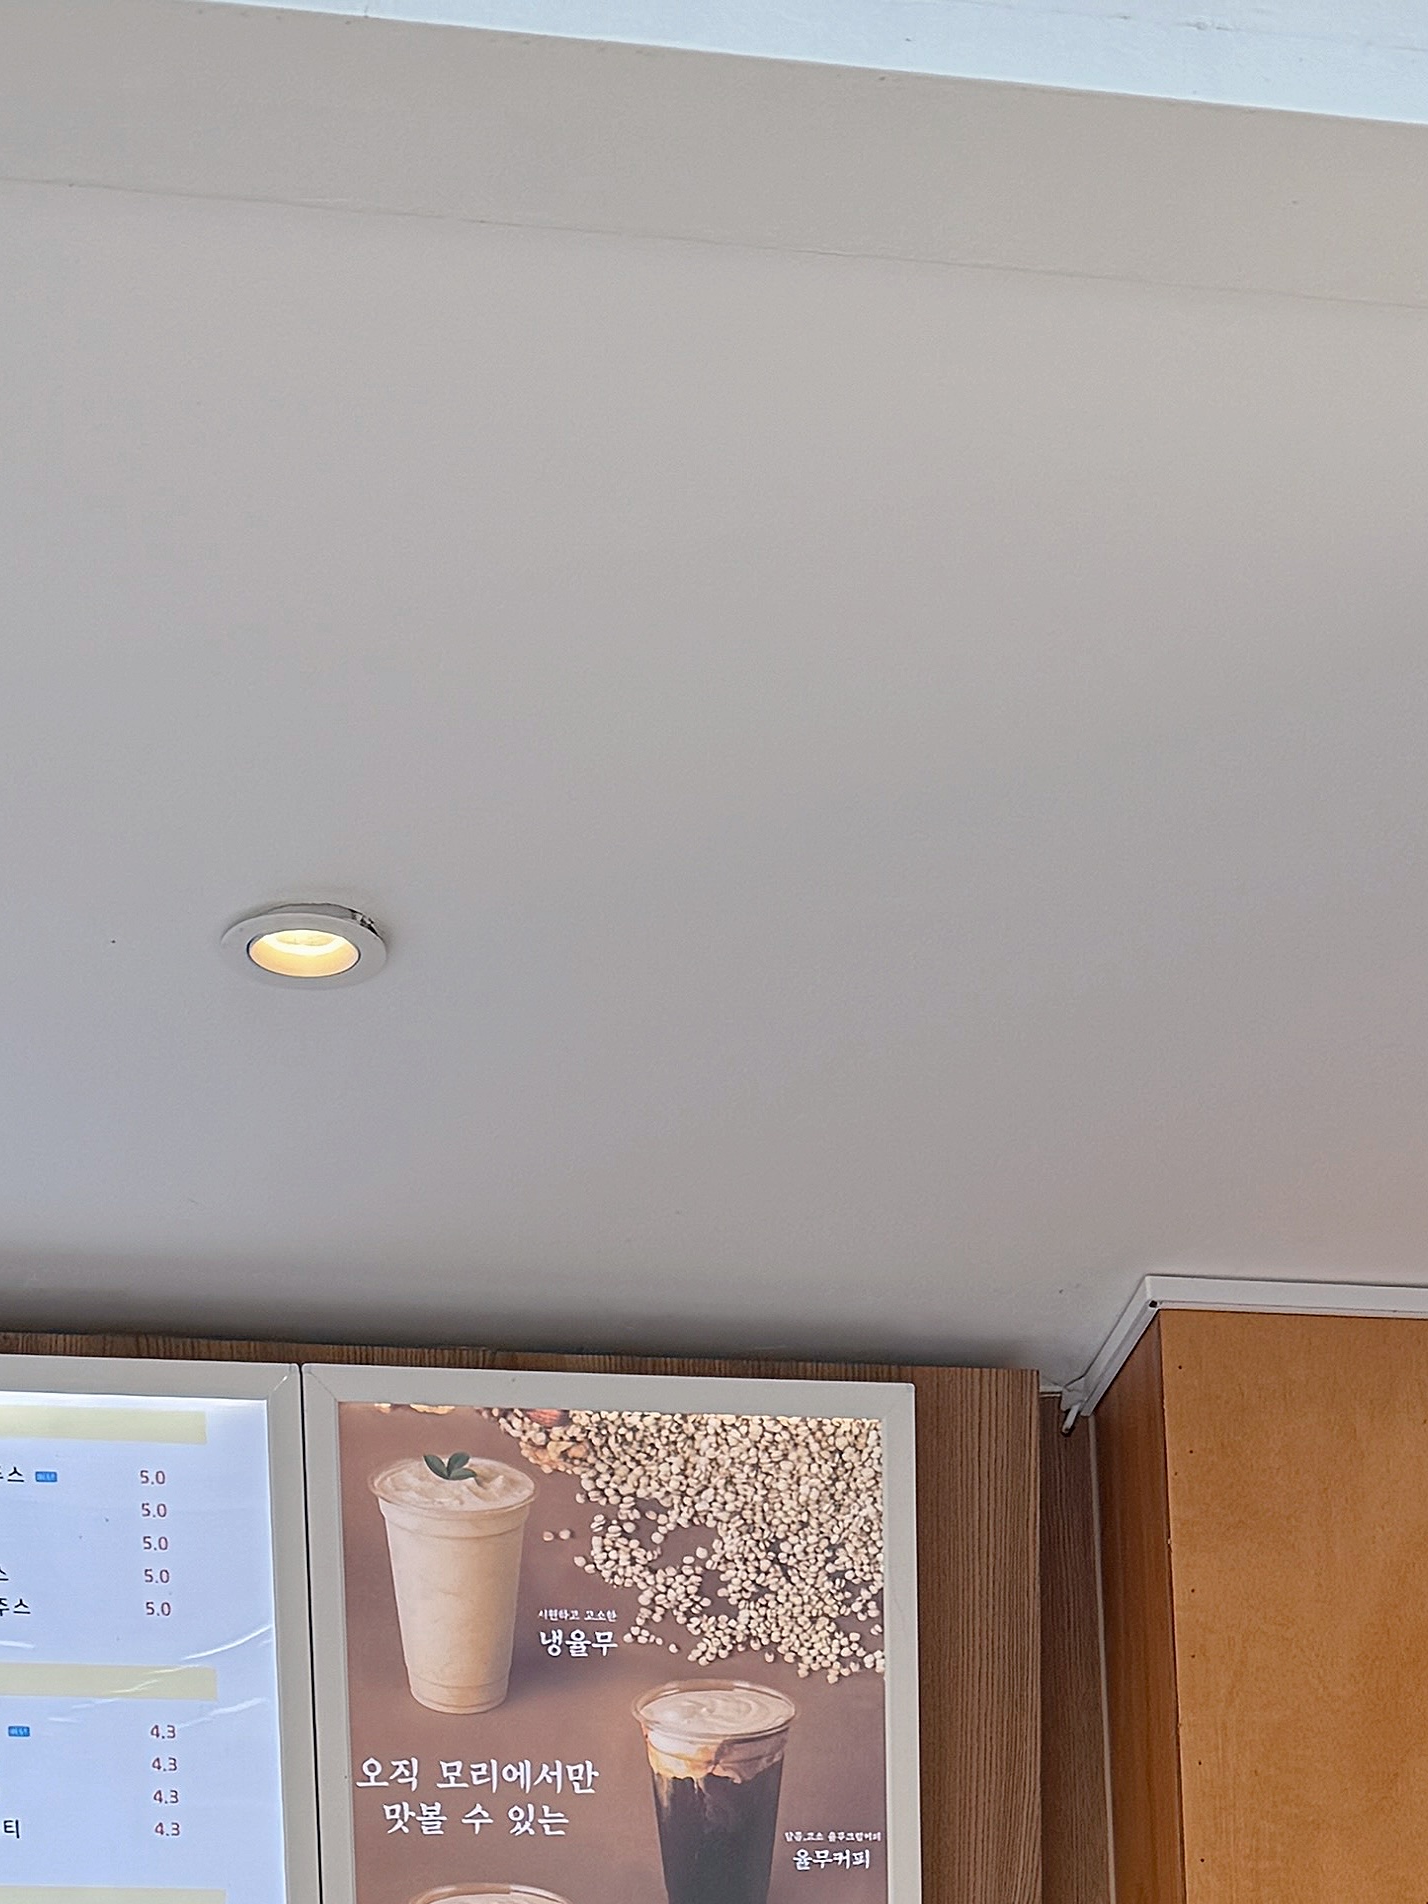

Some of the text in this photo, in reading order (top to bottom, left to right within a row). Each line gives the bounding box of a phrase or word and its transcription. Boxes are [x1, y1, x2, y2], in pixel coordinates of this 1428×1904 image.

[140, 1470, 165, 1484] 5.0
[142, 1503, 166, 1517] 5.0
[143, 1536, 168, 1550] 5.0
[145, 1569, 169, 1583] 5.0
[146, 1602, 171, 1616] 5.0
[539, 1629, 618, 1657] 냉율무
[151, 1725, 175, 1739] 4.3
[152, 1757, 177, 1771] 4.3
[356, 1758, 599, 1793] 오직 모리에서만
[154, 1790, 178, 1804] 4.3
[383, 1802, 569, 1835] 맛볼 수 있는
[155, 1822, 180, 1836] 4.3
[793, 1849, 870, 1870] 율무커피
